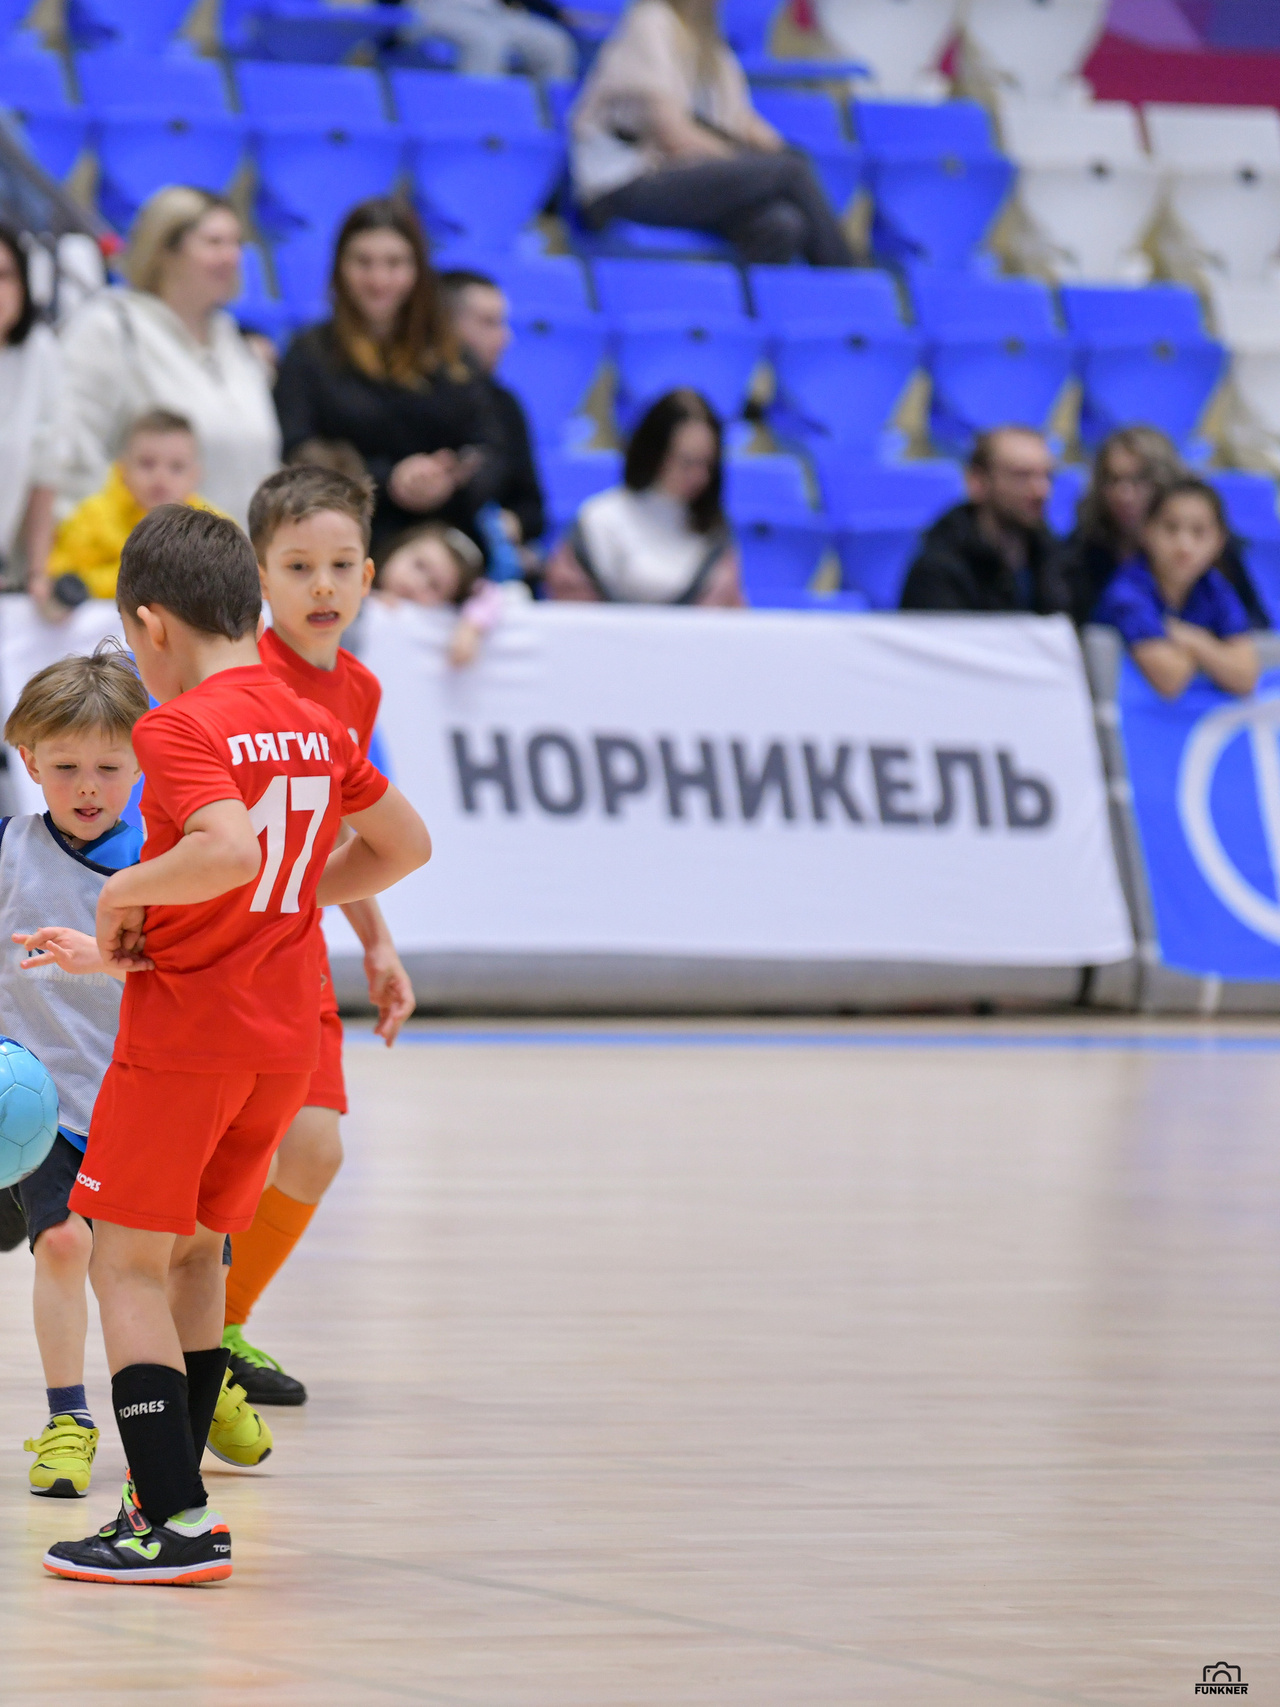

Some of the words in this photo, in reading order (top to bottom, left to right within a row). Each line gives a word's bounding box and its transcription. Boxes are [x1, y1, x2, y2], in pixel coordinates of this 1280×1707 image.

[451, 728, 1057, 831] НОРНИКЕЛЬ
[247, 775, 331, 914] 17
[119, 1400, 165, 1418] TORRES
